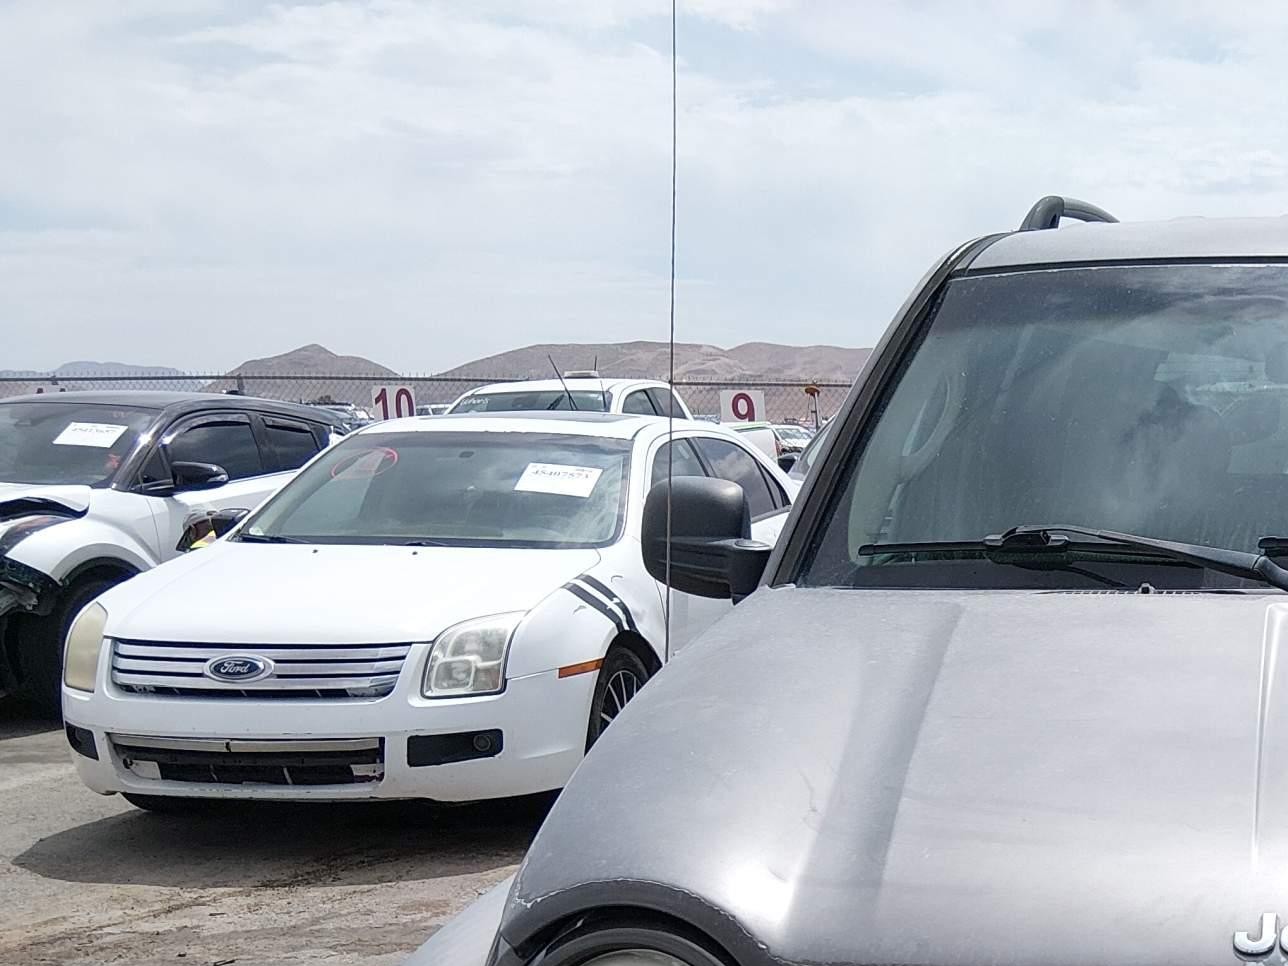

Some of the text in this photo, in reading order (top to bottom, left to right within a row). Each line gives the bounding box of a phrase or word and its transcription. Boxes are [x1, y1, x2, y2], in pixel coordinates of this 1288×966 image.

[374, 388, 415, 420] 10
[731, 392, 755, 421] 9
[220, 660, 251, 673] Ford
